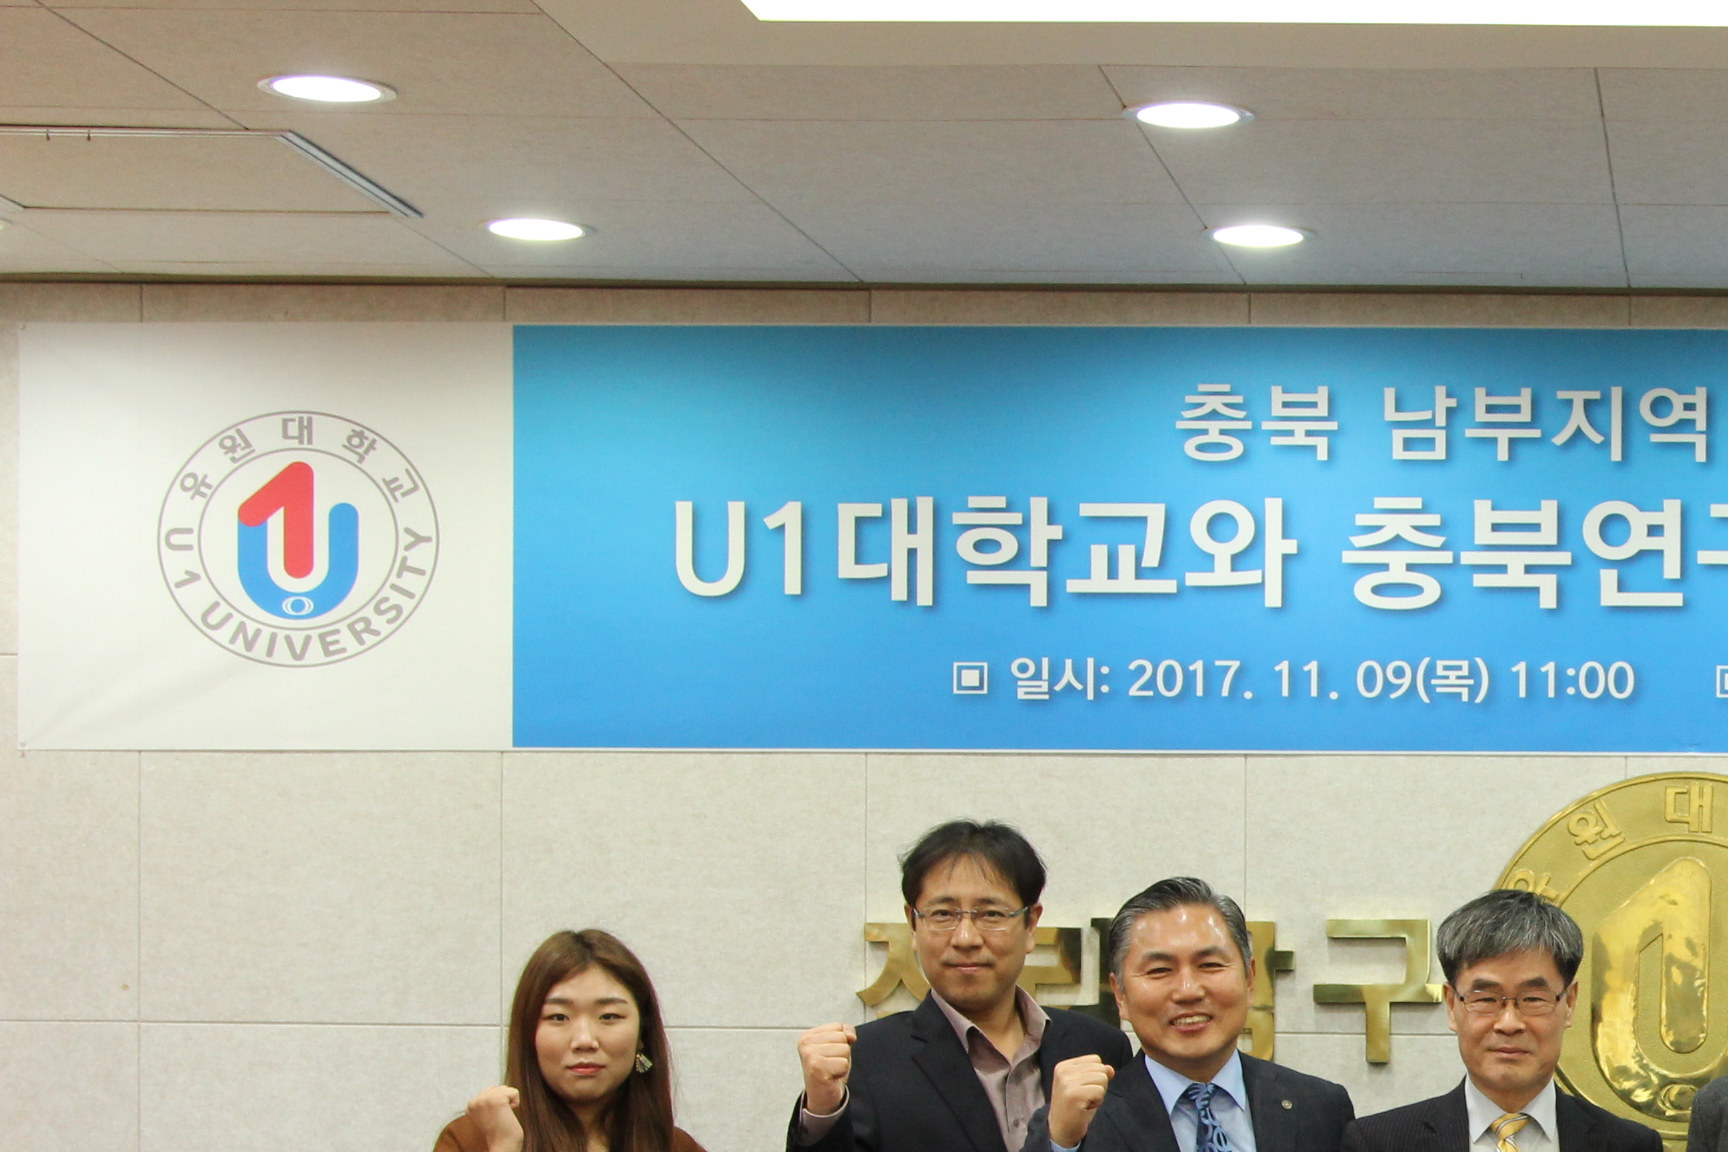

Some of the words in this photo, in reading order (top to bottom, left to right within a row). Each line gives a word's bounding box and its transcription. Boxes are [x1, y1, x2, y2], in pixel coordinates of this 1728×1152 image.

[179, 416, 420, 503] 유원대학교
[1175, 383, 1339, 462] 충북
[1384, 385, 1707, 462] 남부지역
[200, 526, 433, 662] UNIVERSITY
[675, 495, 1298, 608] U1대학교와
[1010, 657, 1110, 700] 일시:
[1128, 658, 1253, 699] 2017.
[1274, 660, 1339, 700] 11.
[1356, 656, 1489, 703] 09(목)
[1511, 660, 1635, 699] 11:00
